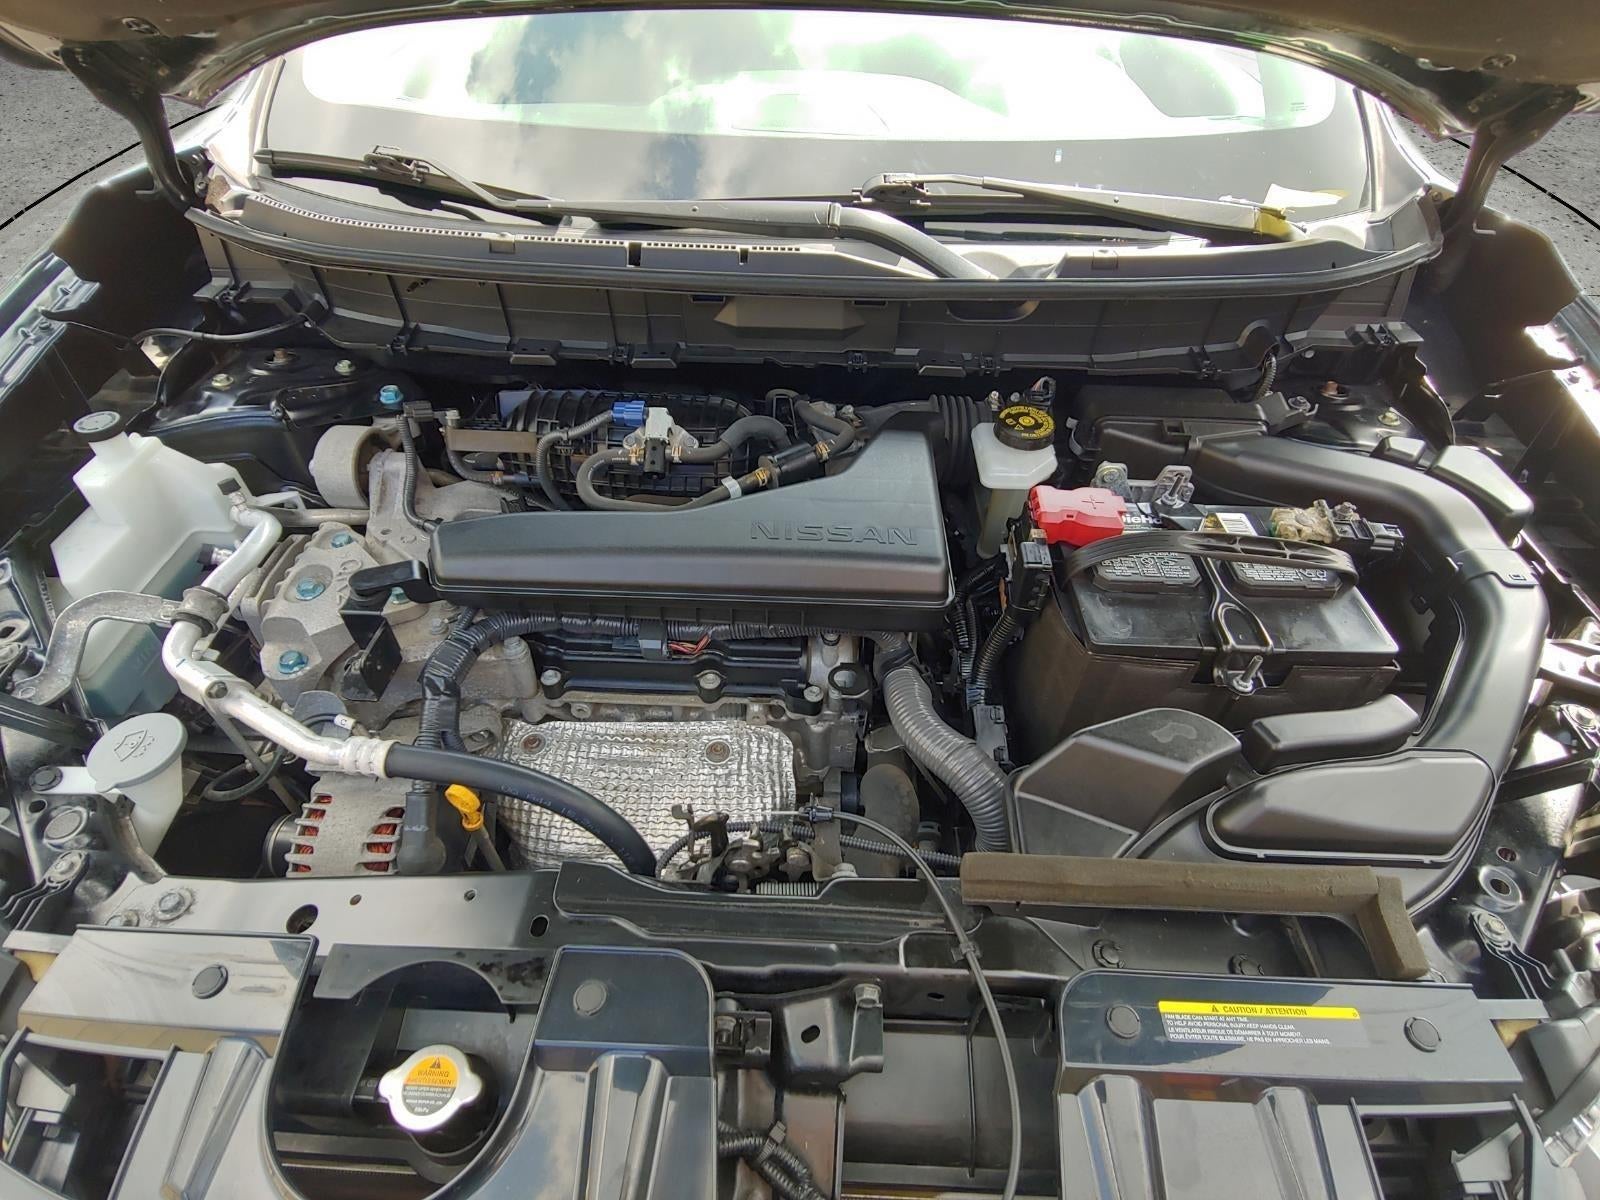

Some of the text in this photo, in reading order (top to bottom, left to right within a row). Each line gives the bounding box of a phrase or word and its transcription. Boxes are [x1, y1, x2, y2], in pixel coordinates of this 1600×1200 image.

[751, 520, 918, 546] NISSAN
[1222, 1006, 1257, 1014] CAUTION
[1265, 1007, 1307, 1016] ATTENTION
[417, 1069, 449, 1078] WARNING
